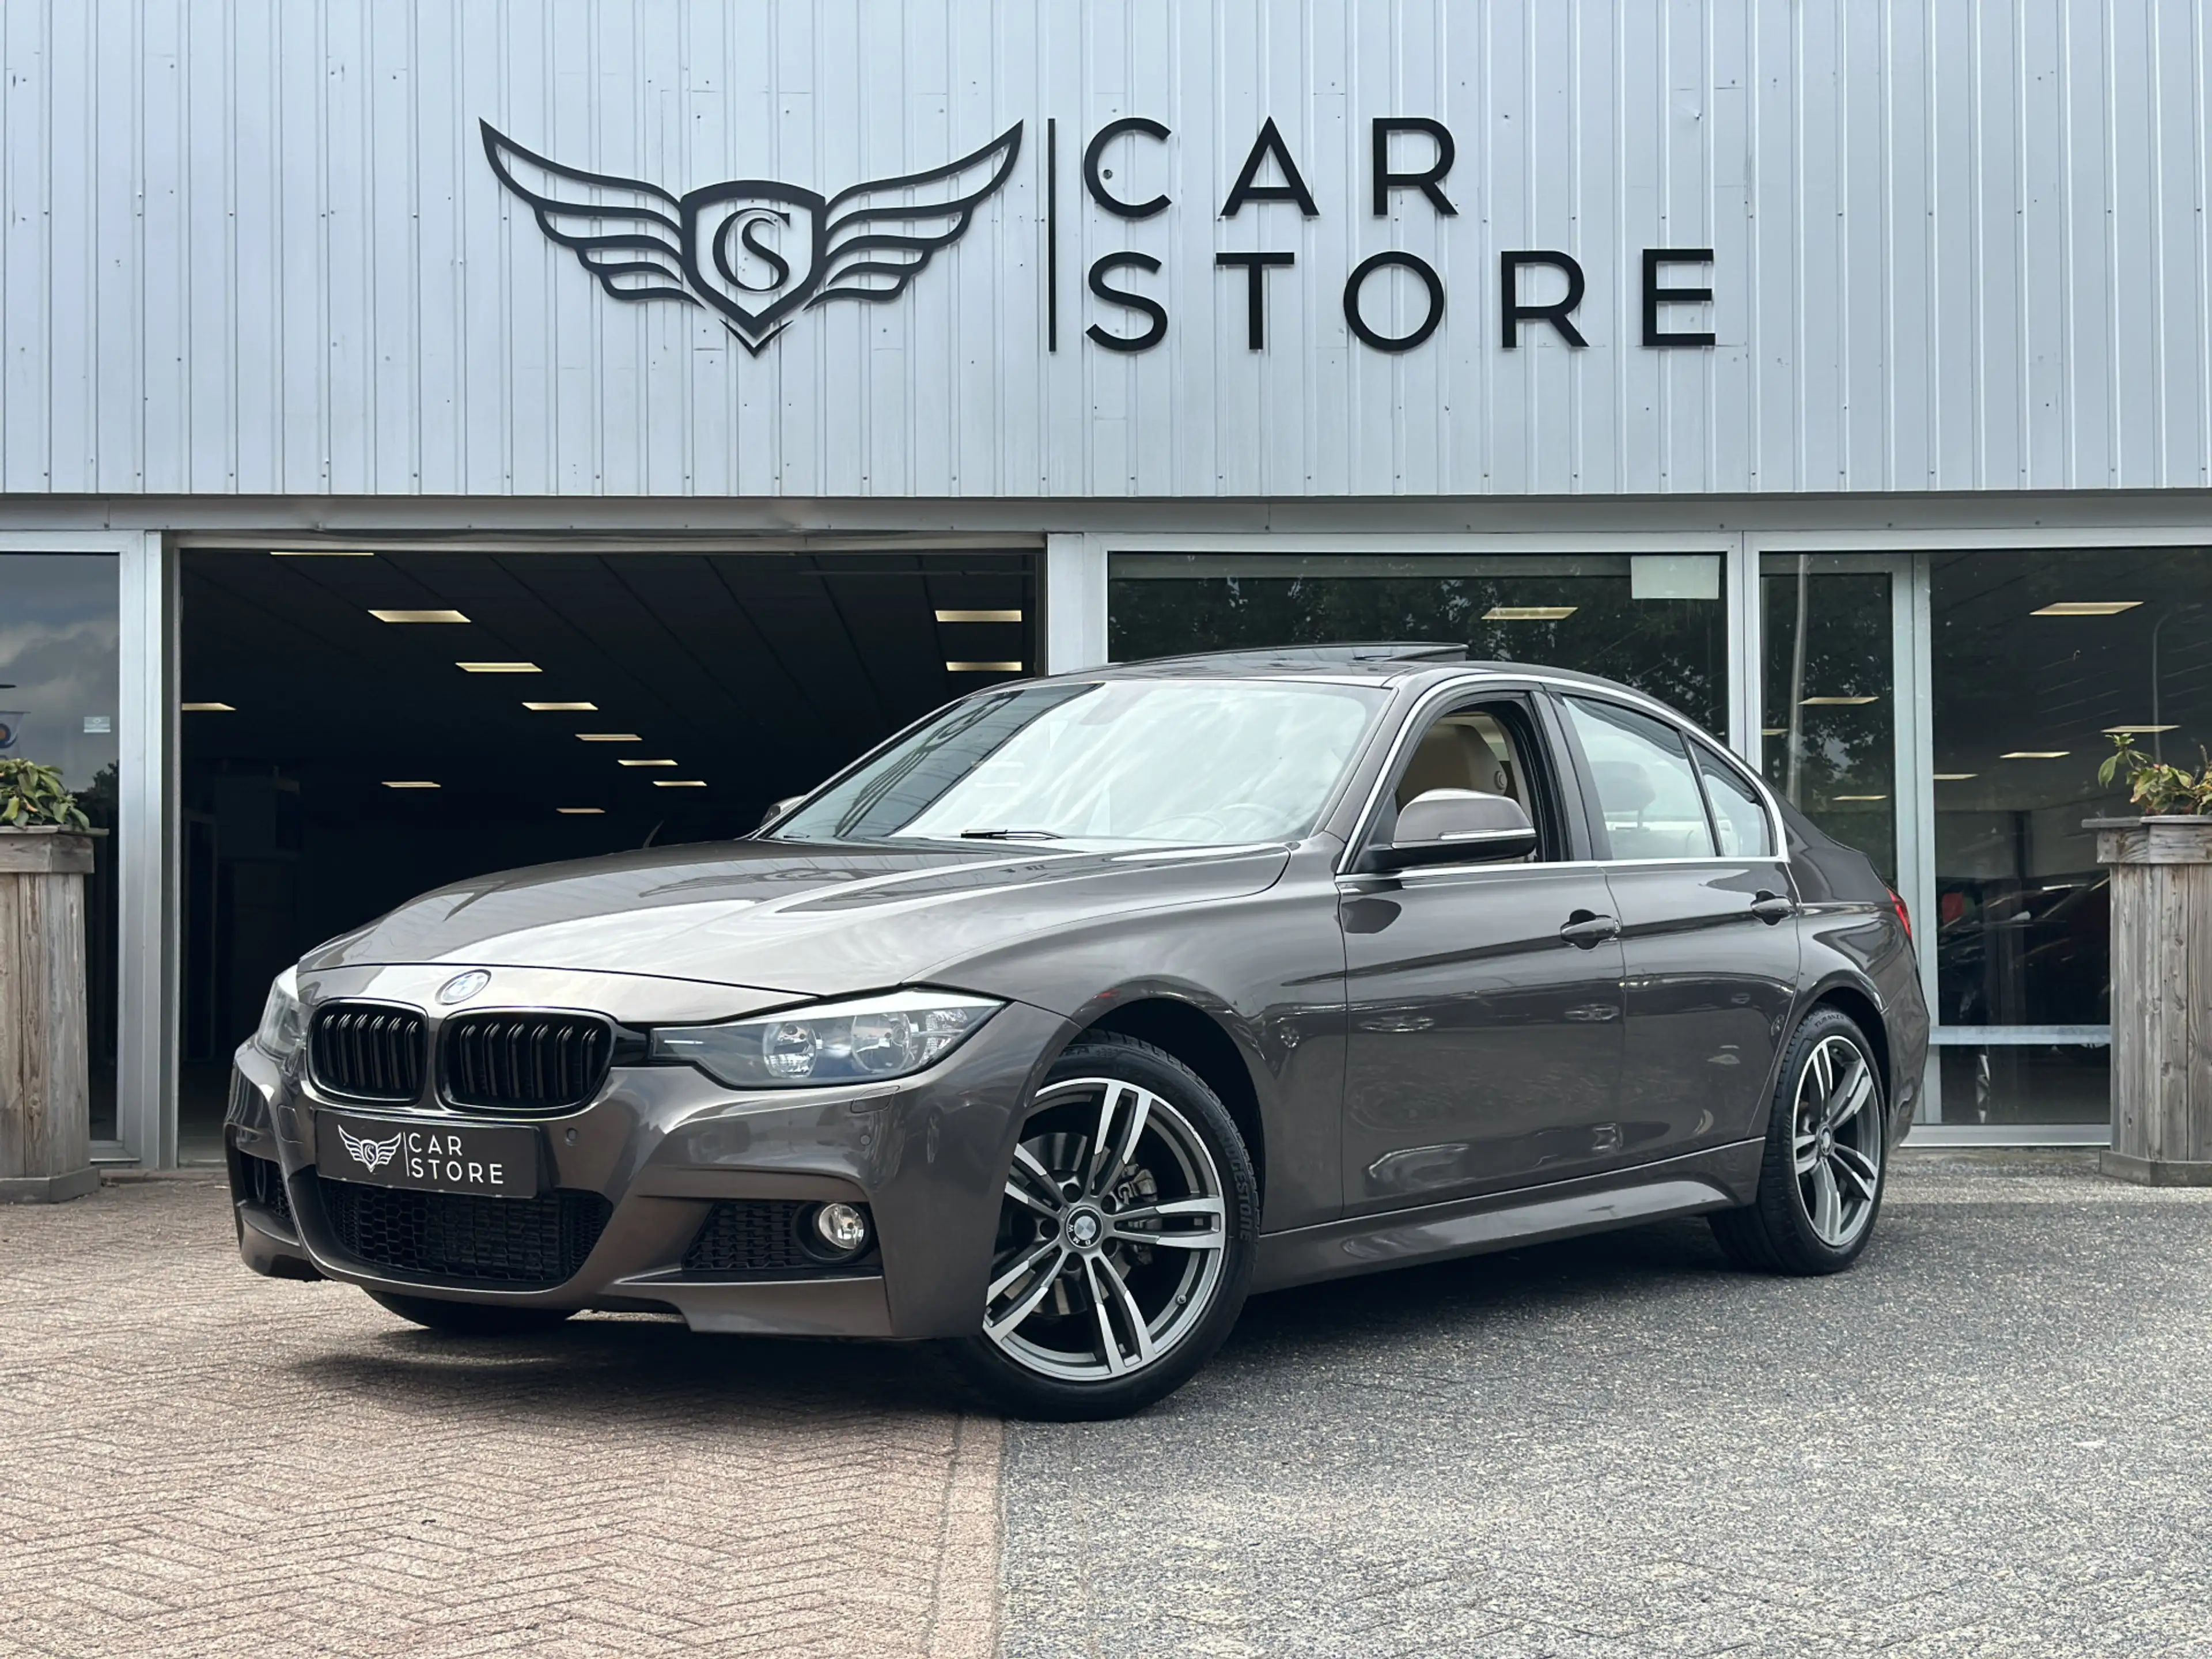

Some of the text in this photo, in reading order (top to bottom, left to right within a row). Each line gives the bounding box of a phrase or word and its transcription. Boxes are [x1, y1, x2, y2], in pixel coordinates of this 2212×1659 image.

[1083, 116, 1459, 218] CAR
[1085, 248, 1715, 352] STORE
[408, 1132, 463, 1156] CAR
[411, 1158, 503, 1184] STORE
